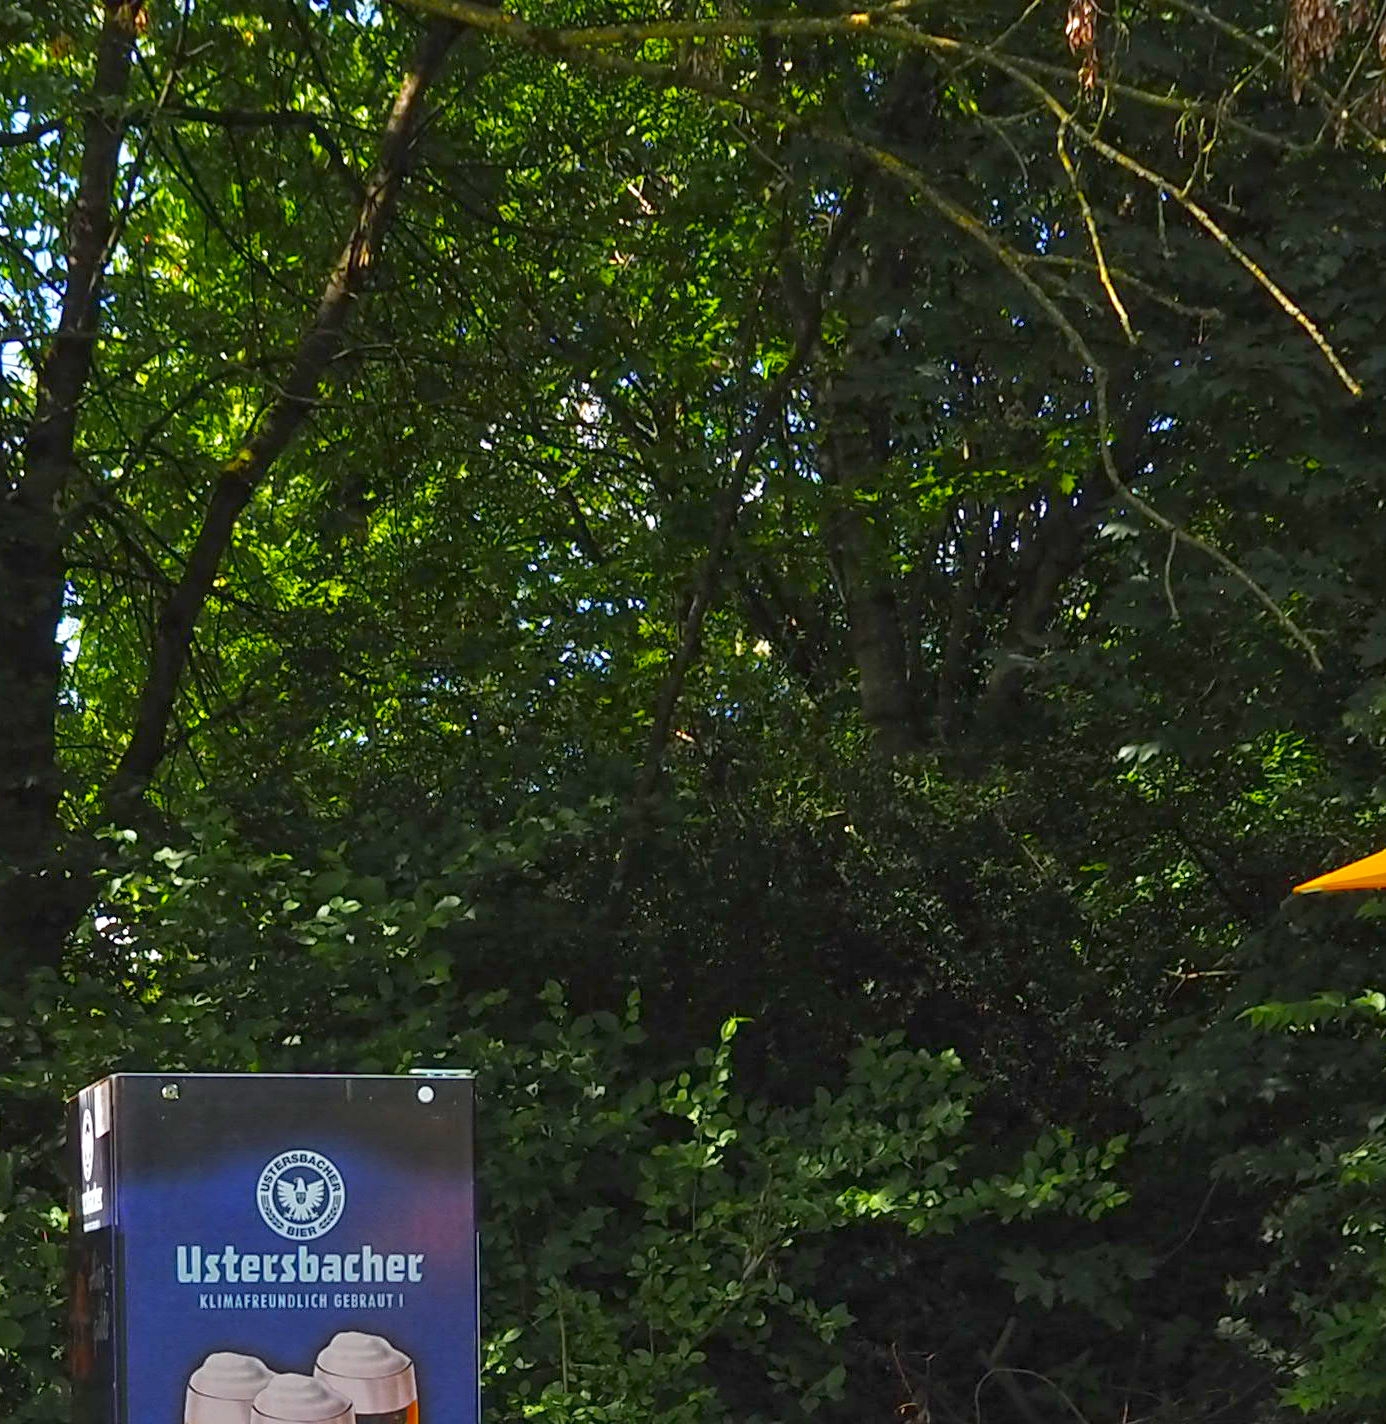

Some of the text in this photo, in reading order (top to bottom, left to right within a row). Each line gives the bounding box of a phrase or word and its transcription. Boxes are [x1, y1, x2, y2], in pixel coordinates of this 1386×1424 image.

[259, 1152, 341, 1194] USTERSBACHER
[286, 1226, 317, 1238] BIER
[176, 1245, 425, 1284] Ustersbacher
[199, 1293, 328, 1310] KLIMAFREUNDLICH
[333, 1292, 394, 1309] GEBRAUT
